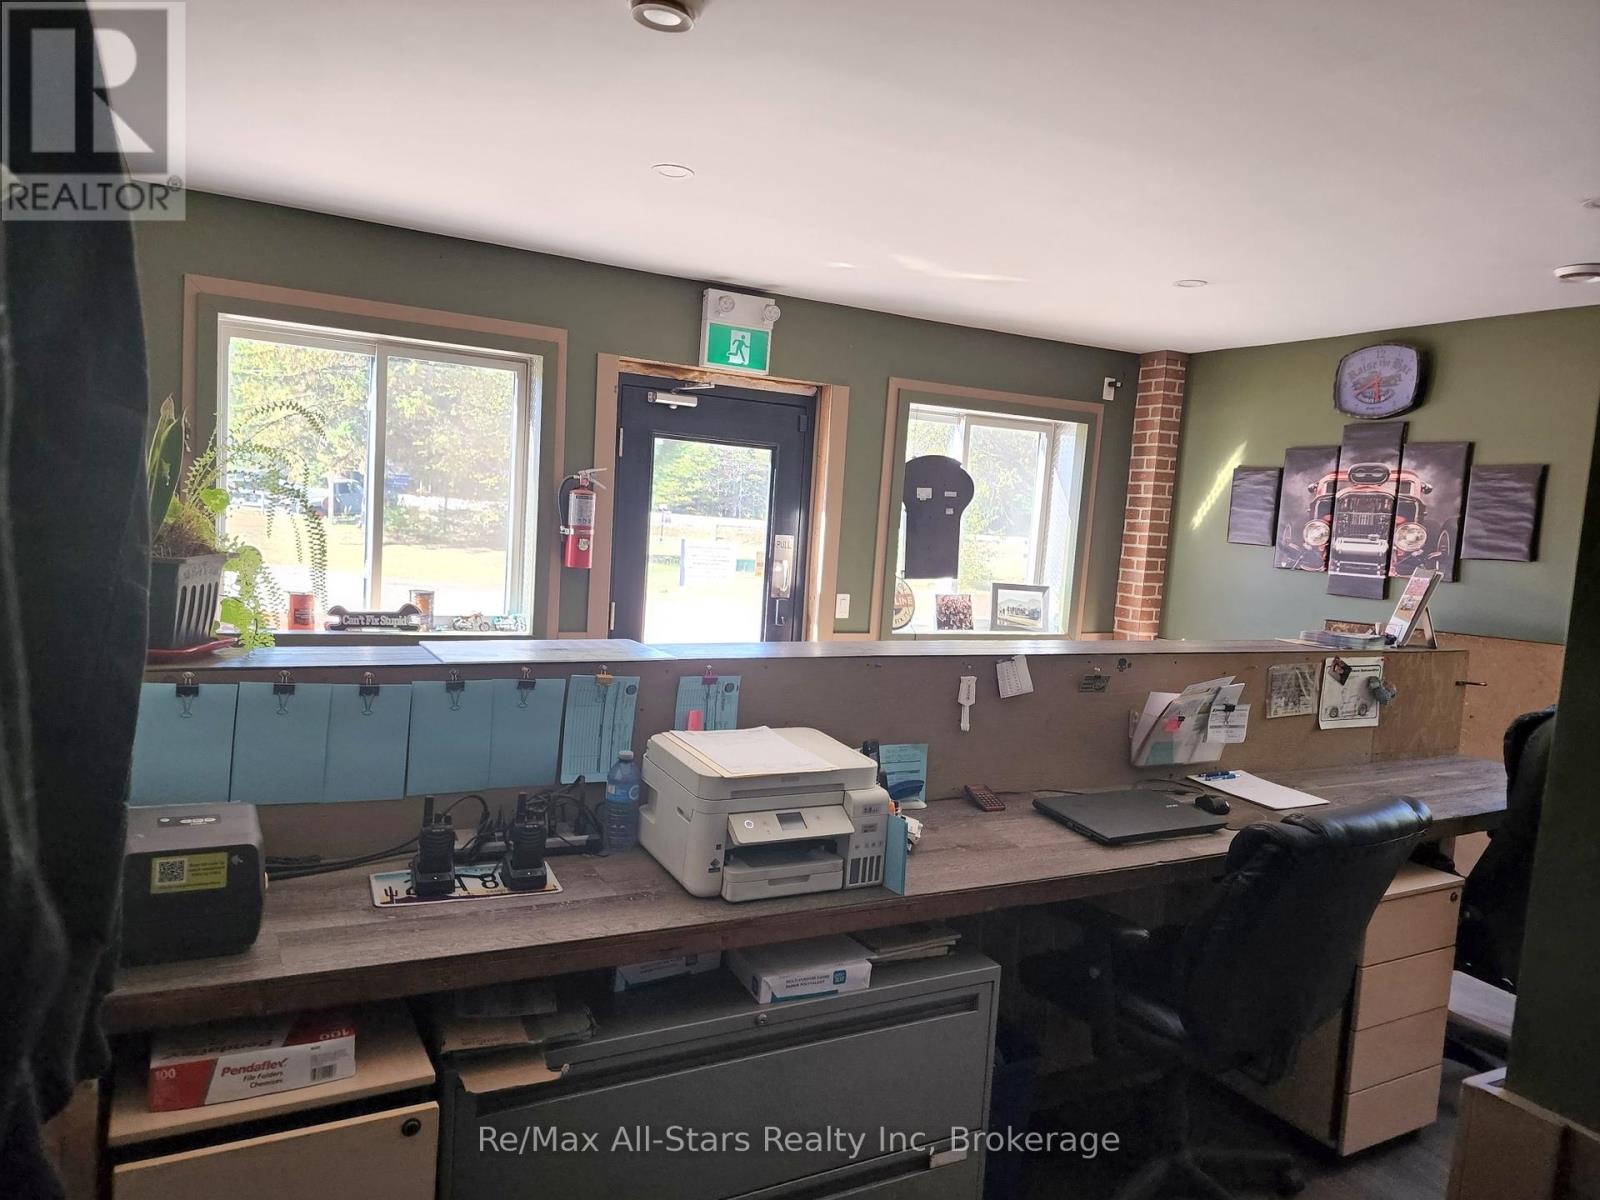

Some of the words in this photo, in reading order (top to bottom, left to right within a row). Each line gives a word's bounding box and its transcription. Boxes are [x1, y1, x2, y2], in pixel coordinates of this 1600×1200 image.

[776, 540, 792, 550] PULL
[342, 615, 364, 625] Can't
[366, 615, 380, 625] Fix
[380, 615, 407, 628] Stupid
[220, 1057, 288, 1077] Pendaflex
[155, 1068, 176, 1080] 100
[257, 1071, 283, 1081] Folders
